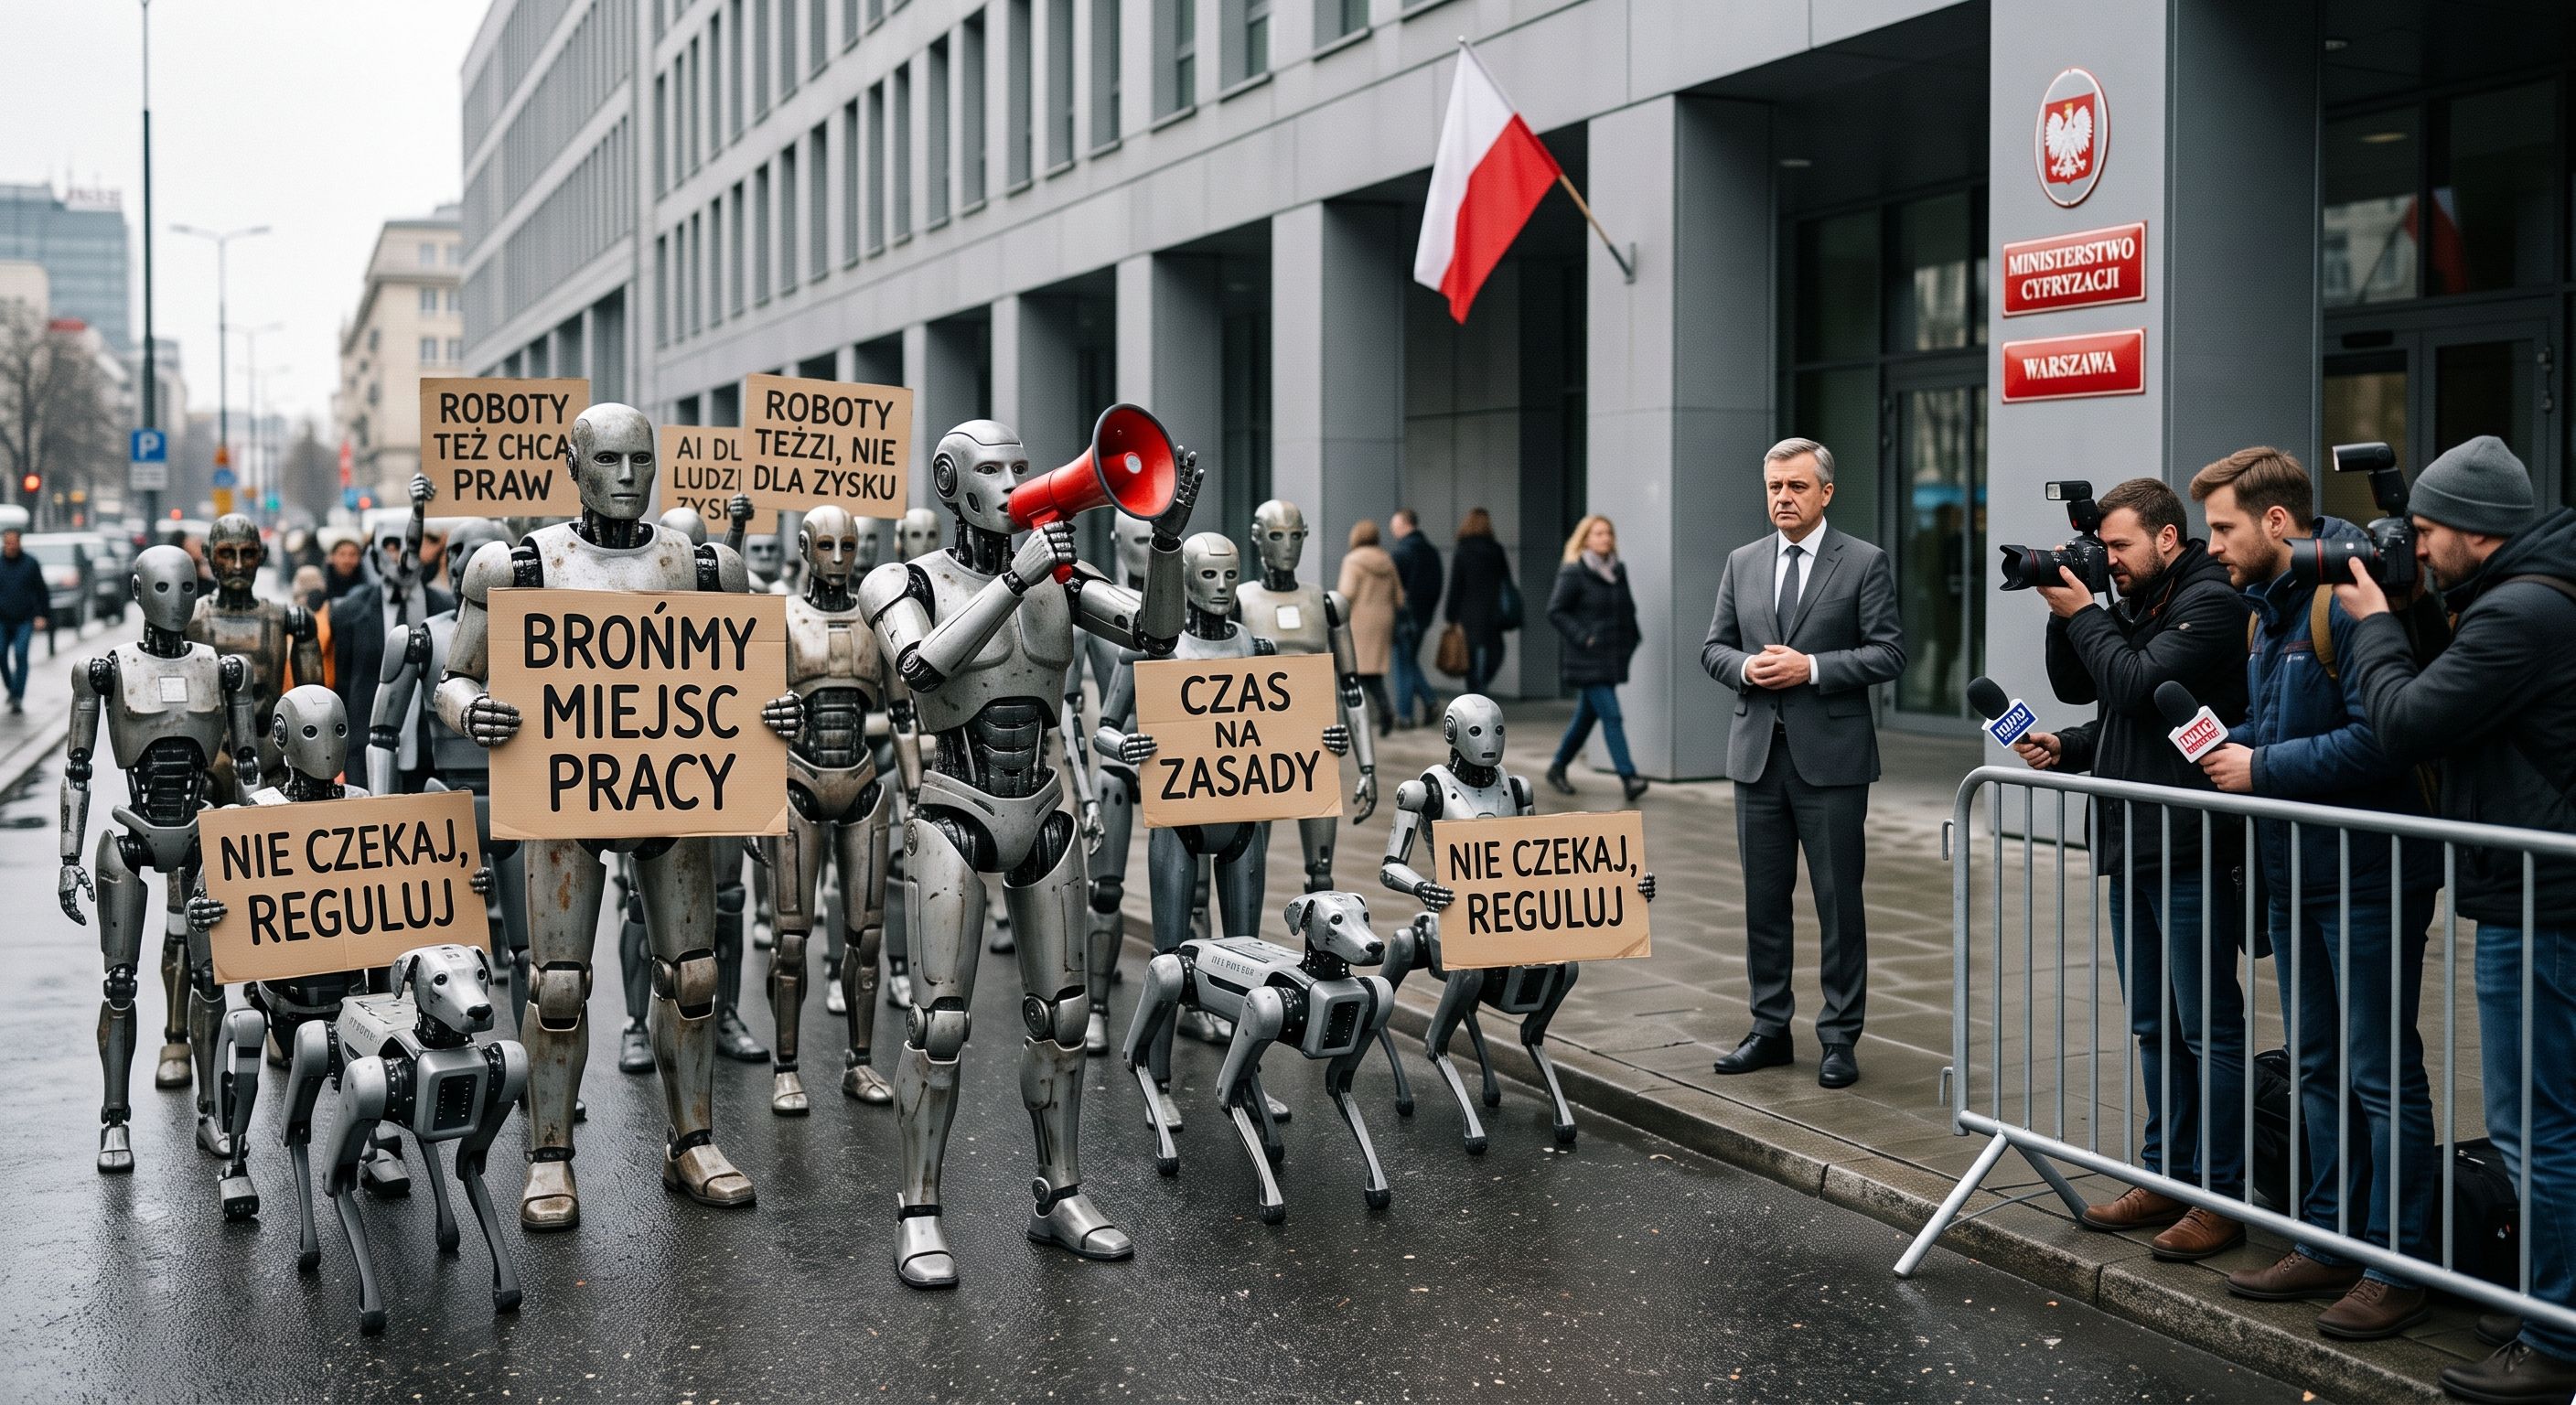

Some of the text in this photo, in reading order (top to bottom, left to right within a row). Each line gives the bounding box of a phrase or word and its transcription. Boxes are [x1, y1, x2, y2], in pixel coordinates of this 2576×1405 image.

[2009, 237, 2135, 277] MINISTERSTWO
[2021, 267, 2120, 301] CYFRYZACJI
[2023, 351, 2116, 381] WARSZAWA
[440, 392, 570, 424] ROBOTY
[766, 390, 894, 431] ROBOTY
[138, 432, 161, 459] P
[433, 426, 488, 461] TEŻ
[676, 435, 743, 462] AI DL
[755, 425, 896, 467] TEŻZI, NIE
[454, 468, 553, 501] PRAW
[754, 464, 896, 500] DLA ZYSKU
[524, 601, 757, 672] BROŃMY
[543, 683, 740, 740] MIEJSC
[1180, 671, 1291, 715] CZAS
[1215, 719, 1261, 749] NA
[549, 753, 736, 812] PRACY
[1159, 750, 1321, 800] ZASADY
[220, 818, 468, 882] NIE CZEKAJ,
[1449, 834, 1637, 881] NIE CZEKAJ,
[248, 877, 455, 946] REGULUJ
[1467, 885, 1624, 935] REGULUJ
